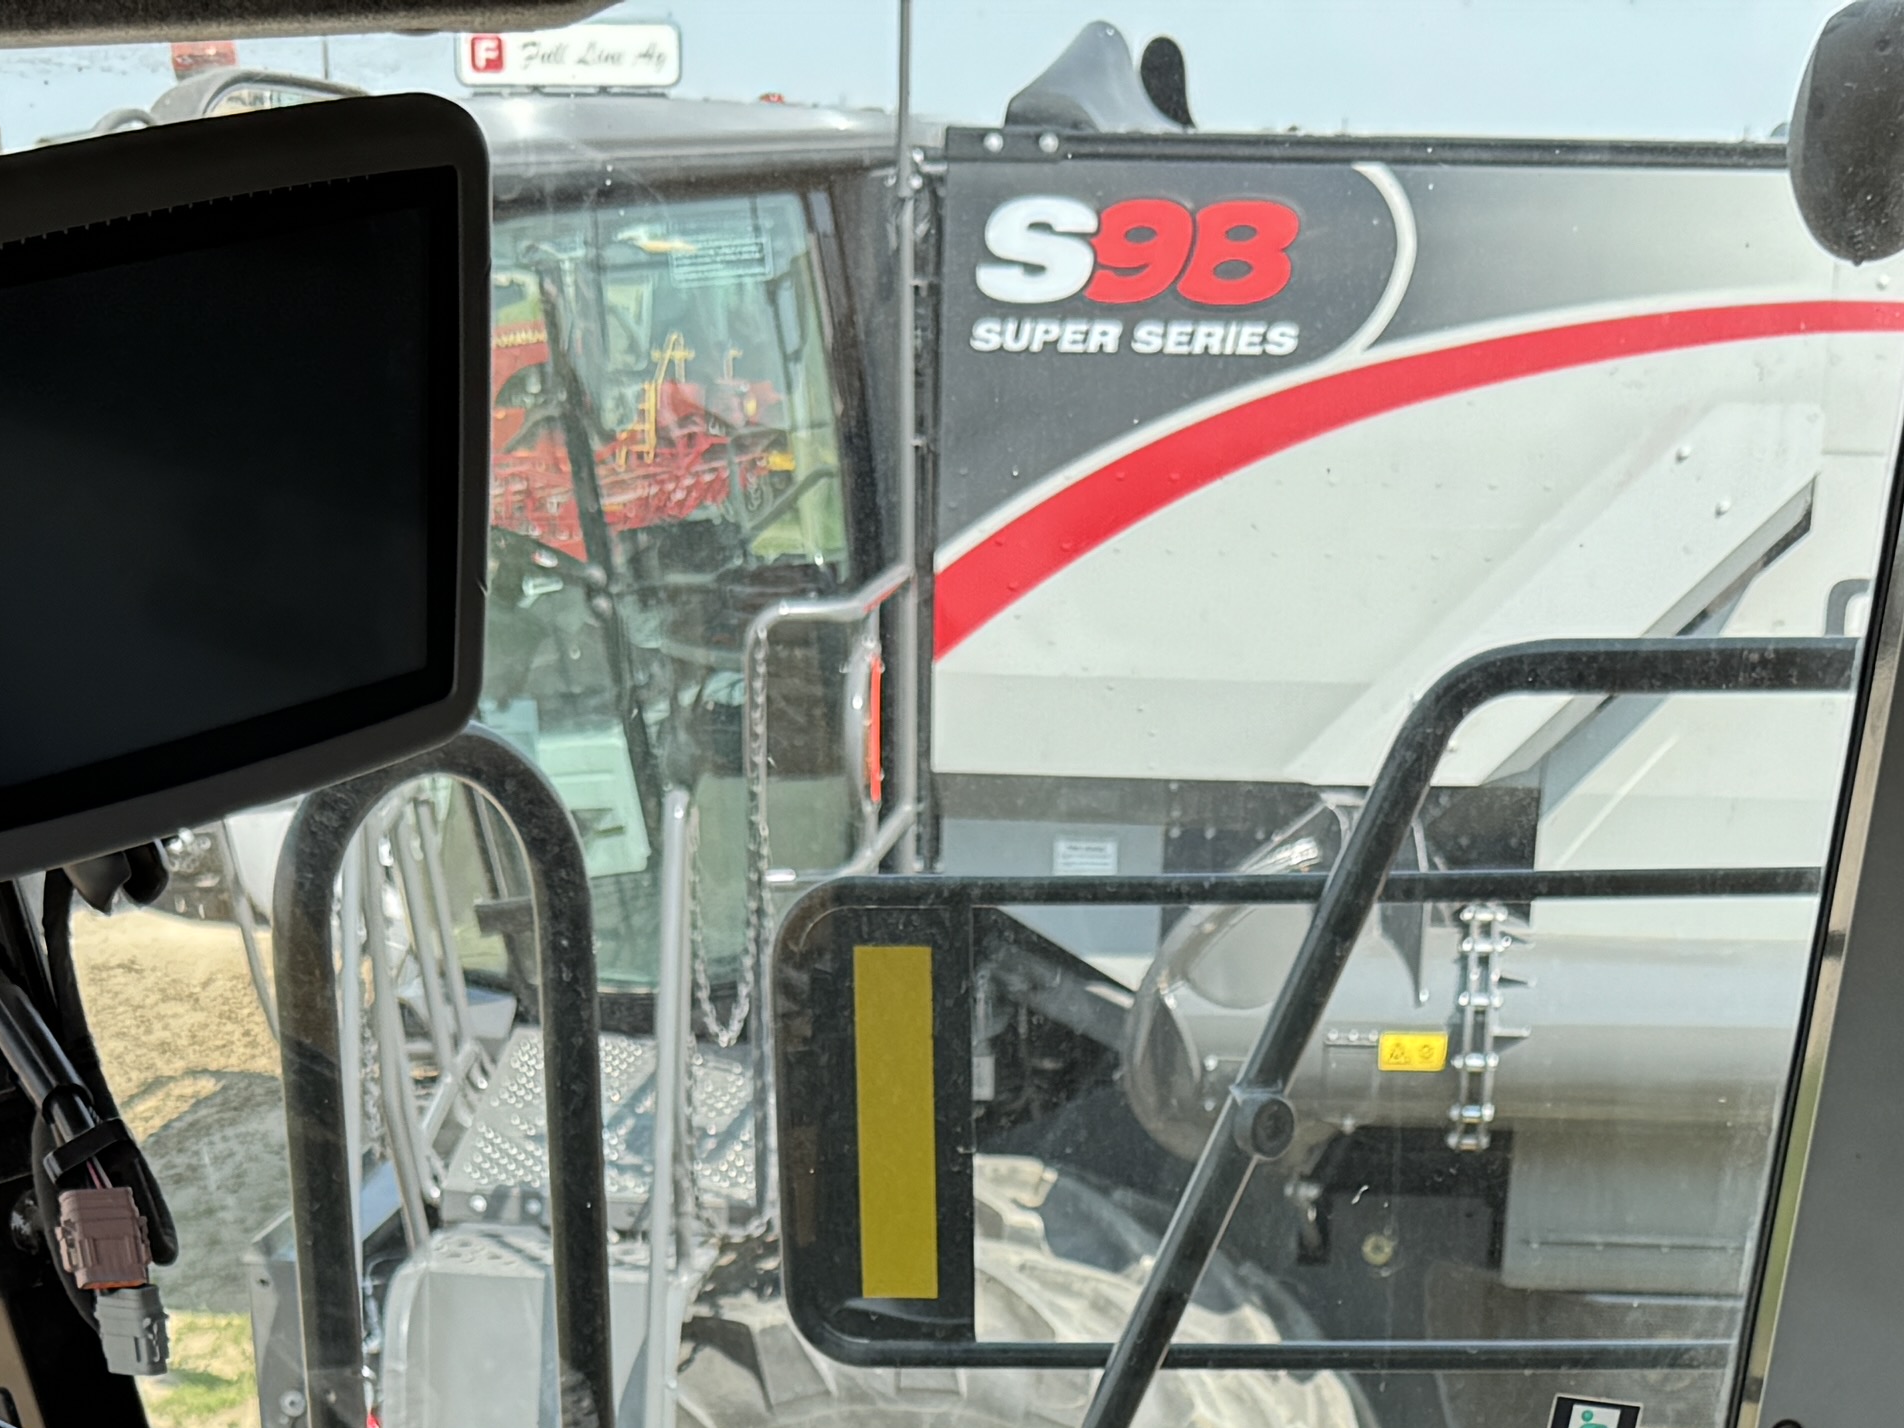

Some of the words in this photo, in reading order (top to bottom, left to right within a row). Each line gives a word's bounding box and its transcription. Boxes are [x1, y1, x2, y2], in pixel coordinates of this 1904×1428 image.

[473, 37, 502, 71] F
[519, 40, 570, 70] Full
[576, 41, 625, 66] Line
[976, 195, 1300, 306] S98
[970, 317, 1123, 353] SUPER
[1131, 319, 1300, 355] SERIES
